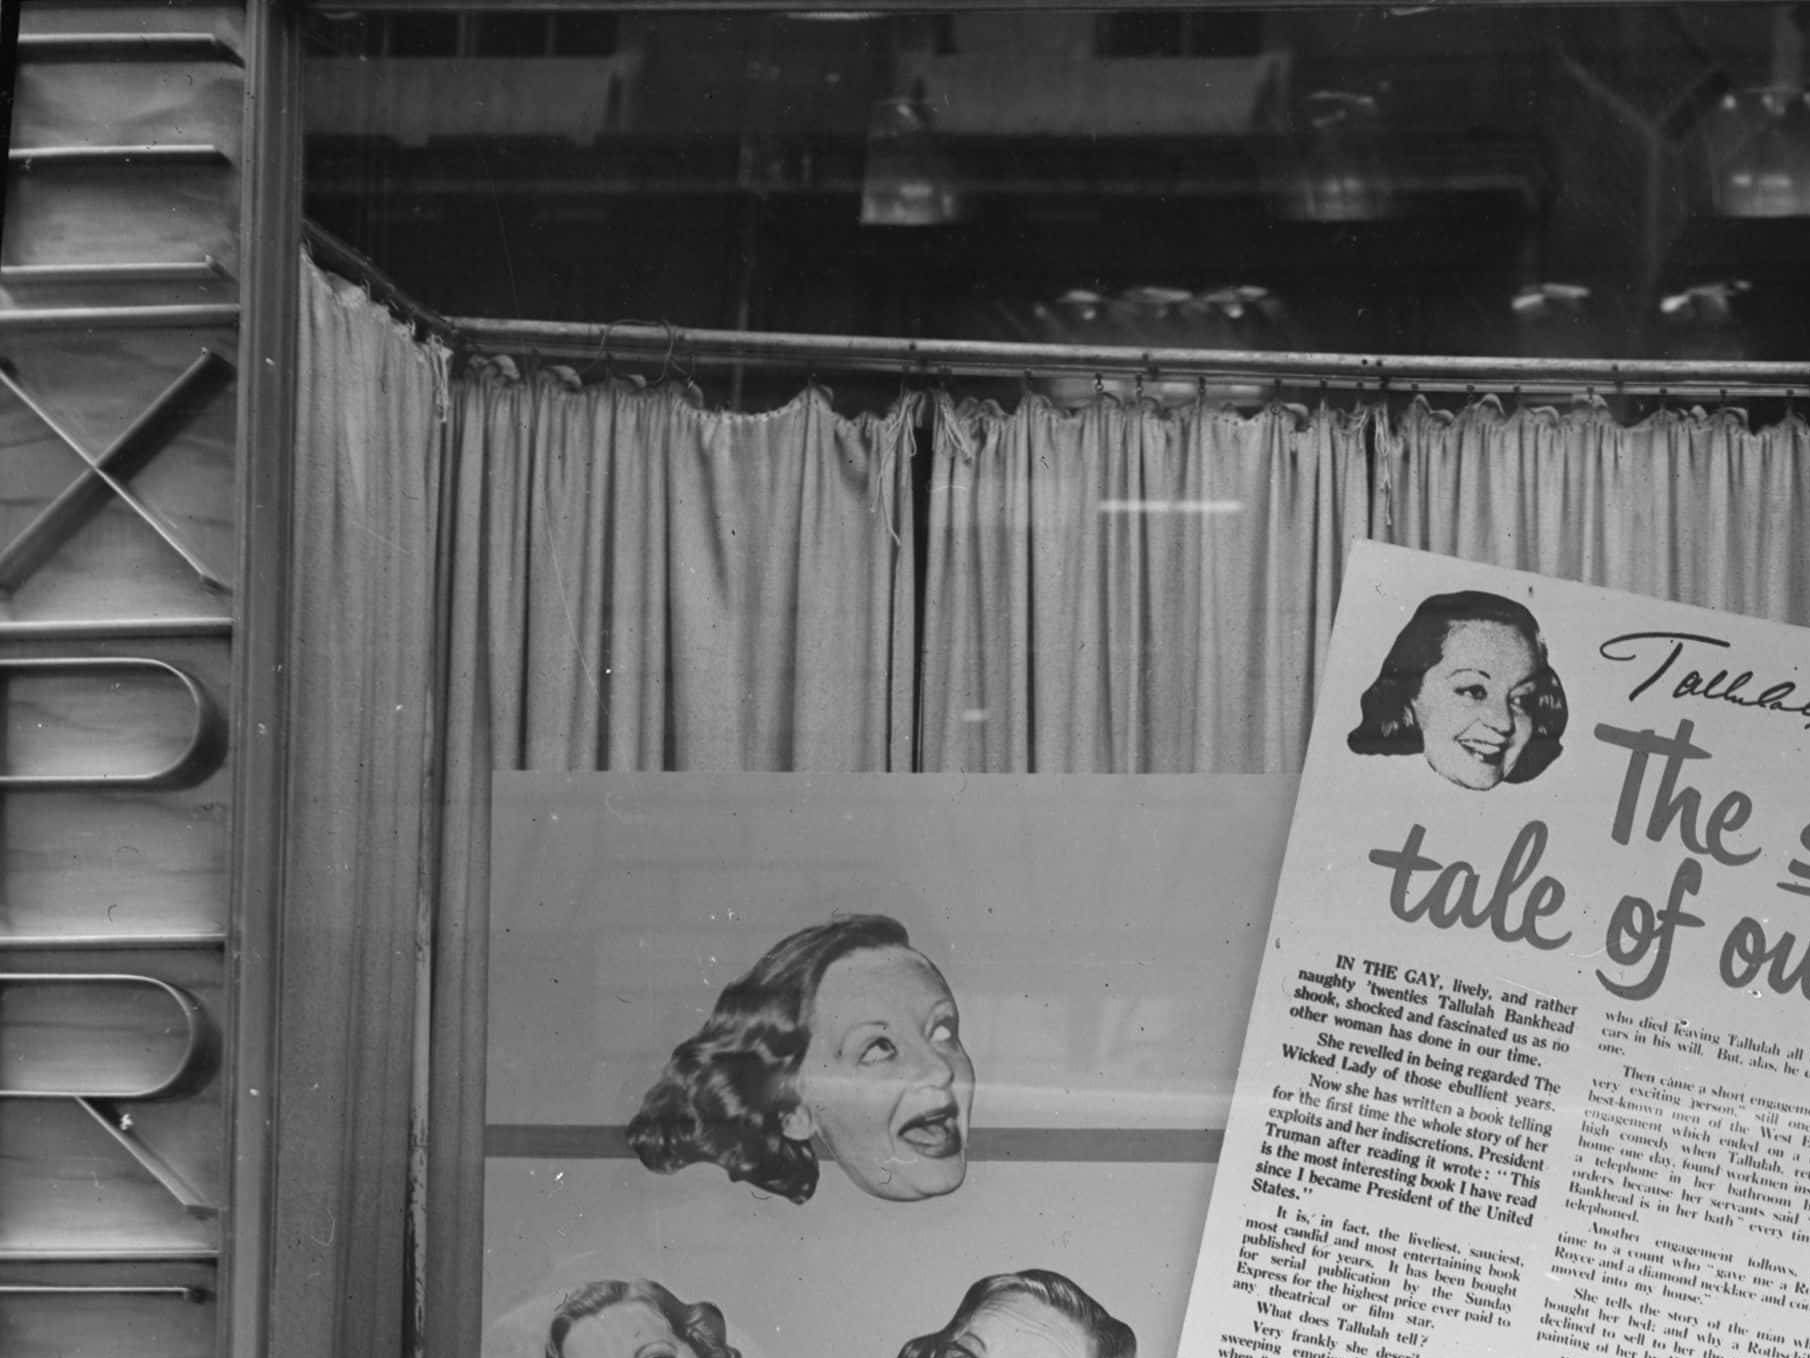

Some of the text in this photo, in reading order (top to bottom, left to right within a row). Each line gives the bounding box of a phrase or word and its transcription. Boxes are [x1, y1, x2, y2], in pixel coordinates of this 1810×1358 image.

[1594, 719, 1760, 868] The
[1369, 820, 1572, 951] tale
[1598, 858, 1705, 1000] of
[1298, 969, 1355, 992] naughty
[1438, 994, 1494, 1018] Tallulah
[1504, 1008, 1574, 1034] Bankhead
[1336, 954, 1355, 970] IN
[1363, 959, 1397, 979] THE
[1404, 969, 1443, 990] GAY,
[1500, 992, 1527, 1005] and
[1534, 998, 1577, 1015] rather
[1289, 1005, 1540, 1066] other woman has done in our time.
[1293, 985, 1569, 1052] shook, shocked and fascinated us as no
[1282, 1043, 1554, 1111] Wicked Lady of those ebullient years.
[1316, 1032, 1560, 1093] She revelled in being regarded The
